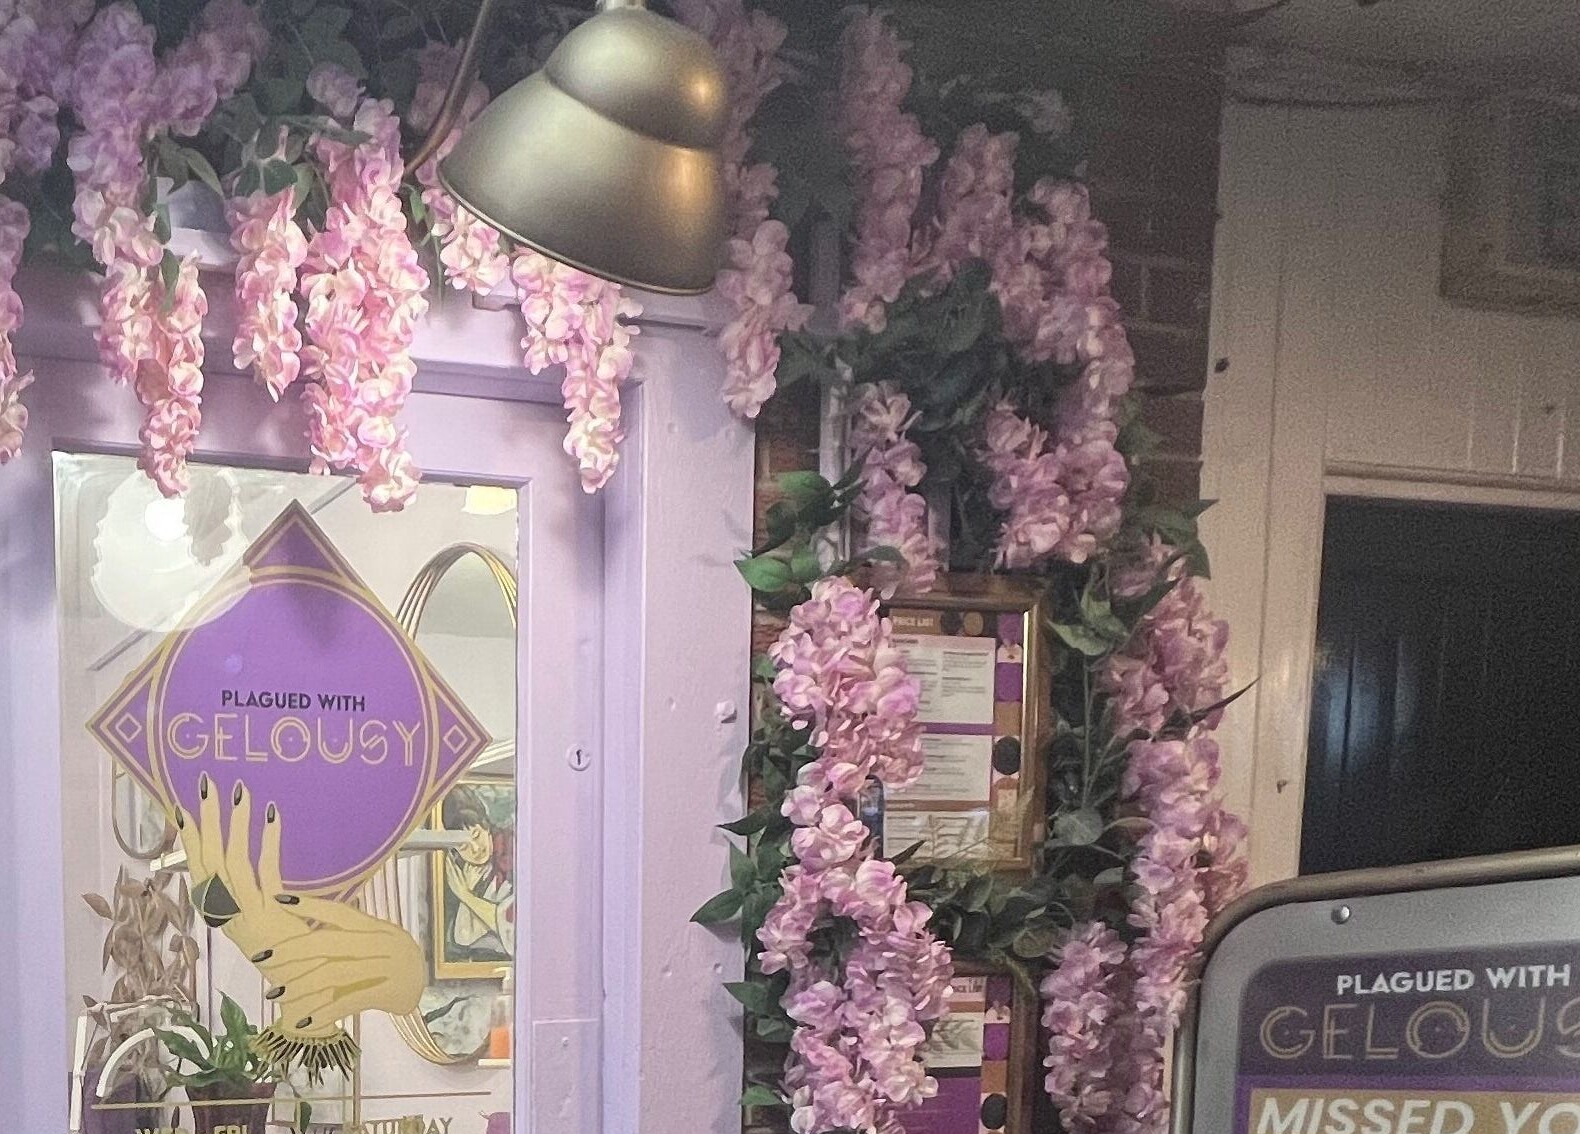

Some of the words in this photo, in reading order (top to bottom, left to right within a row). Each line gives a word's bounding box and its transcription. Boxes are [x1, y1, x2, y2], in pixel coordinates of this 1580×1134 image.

[221, 689, 312, 709] PLAGUED
[318, 693, 365, 712] WITH
[167, 712, 421, 766] GELOUSY
[1337, 969, 1475, 996] PLAGUED
[1485, 964, 1571, 989] WITH
